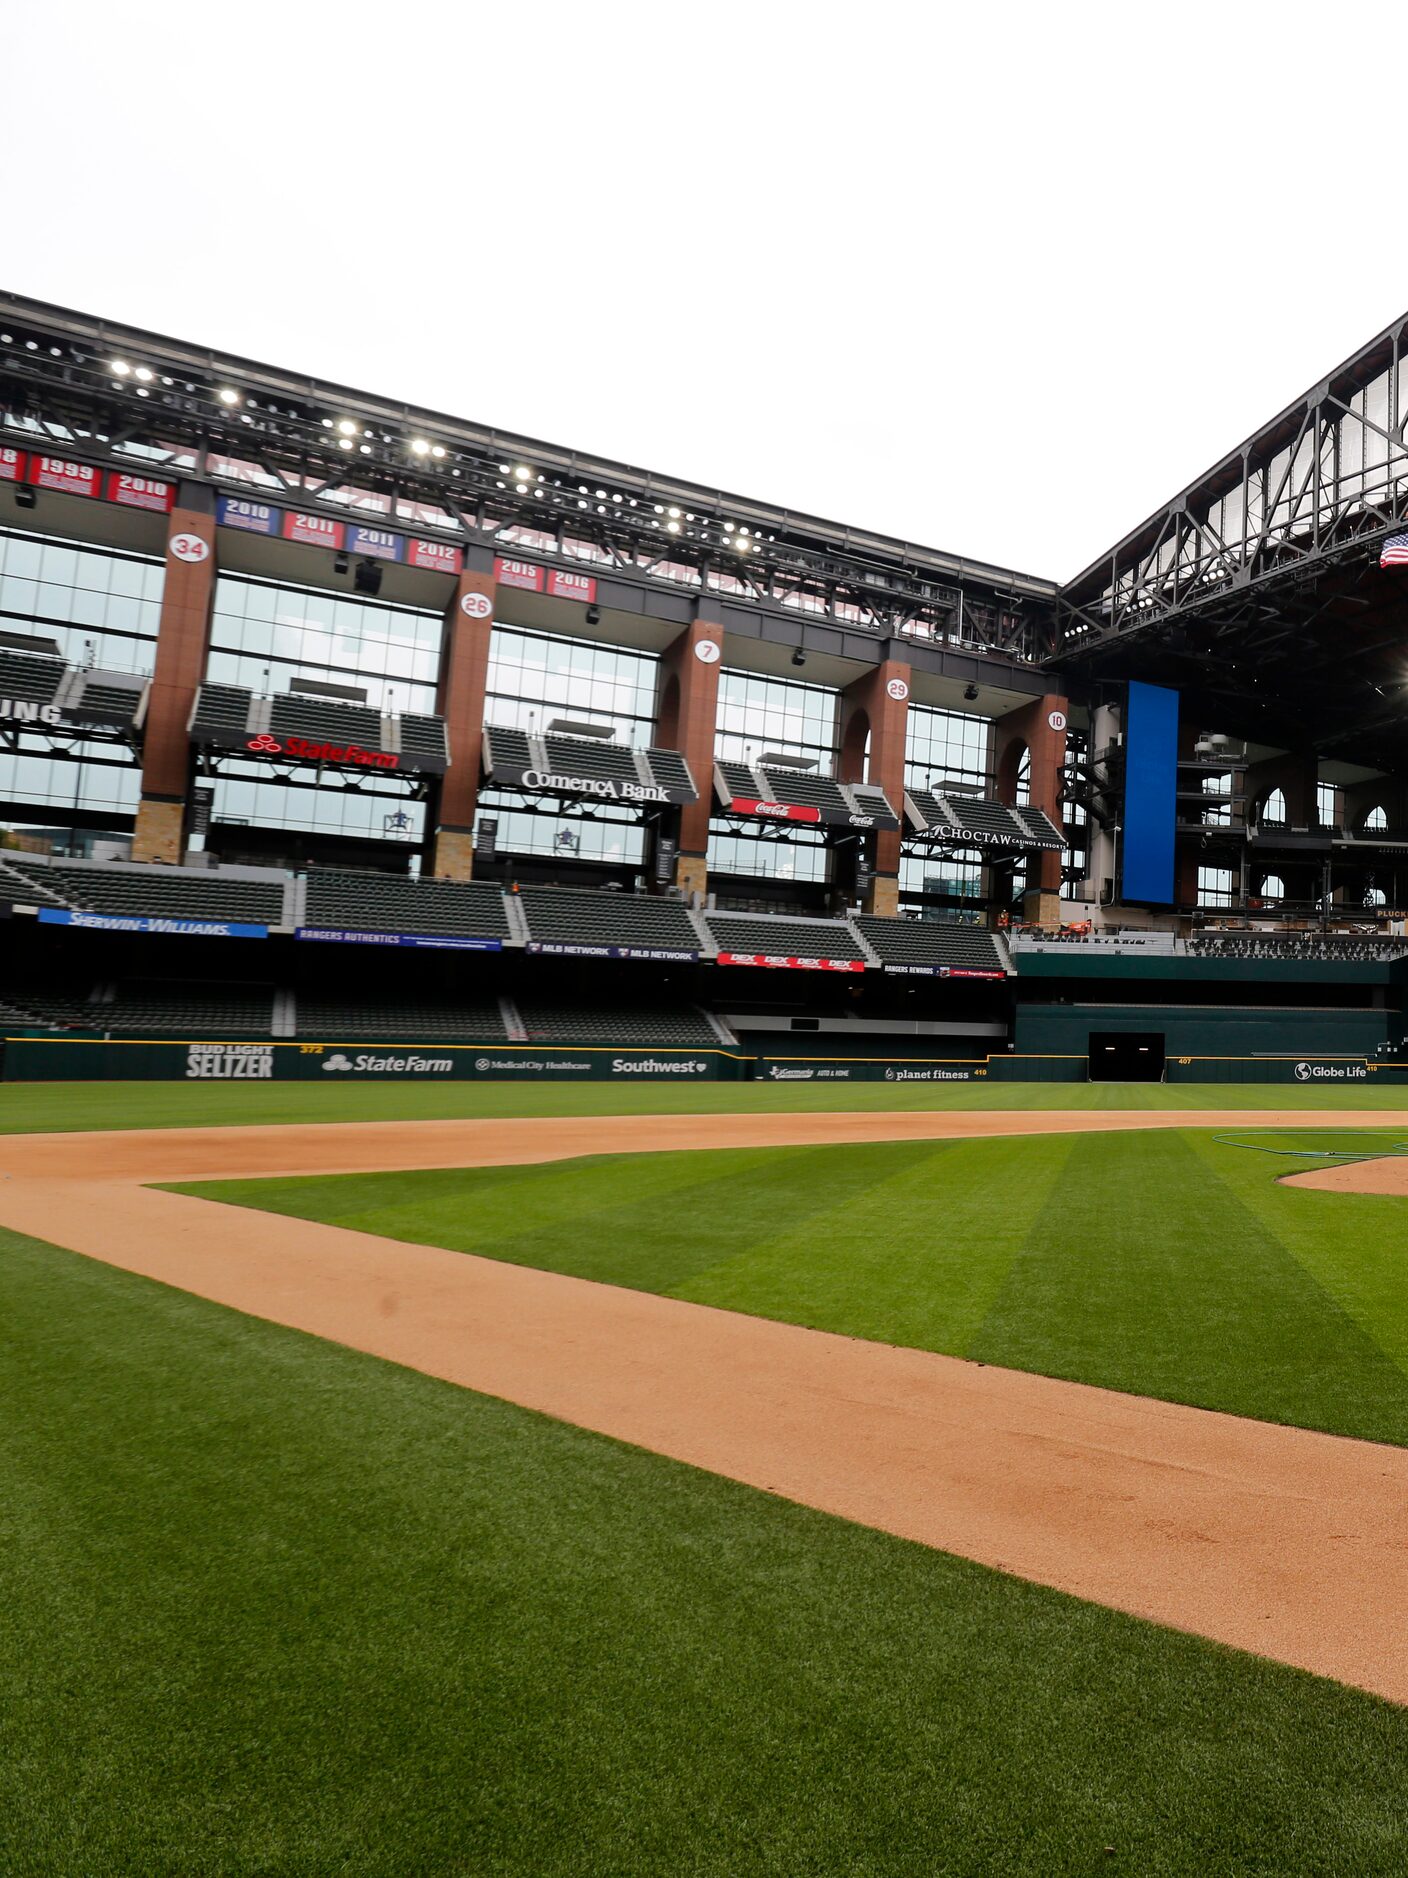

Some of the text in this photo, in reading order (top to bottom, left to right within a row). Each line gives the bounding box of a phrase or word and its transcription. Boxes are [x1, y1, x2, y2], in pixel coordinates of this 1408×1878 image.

[41, 457, 94, 480] 1999
[120, 475, 168, 496] 2010
[227, 499, 270, 520] 2010
[296, 514, 334, 533] 2011
[358, 528, 394, 547] 2011
[176, 539, 203, 558] 34
[417, 541, 456, 560] 2012
[502, 561, 536, 577] 2015
[555, 571, 589, 588] 2016
[466, 597, 487, 613] 26
[704, 645, 713, 657] 7
[890, 683, 906, 696] 29
[1052, 715, 1062, 727] 10
[620, 782, 671, 802] Bank
[755, 802, 791, 816] Coca-Cola
[849, 815, 875, 826] Coca-Cola
[940, 825, 1011, 845] CHOCTAW
[300, 929, 342, 940] RANGERS
[344, 932, 399, 943] AUTHENTICS
[542, 944, 692, 960] MLB NETWORK MLB NETWORK
[884, 965, 933, 974] RANGERS REWARDS
[189, 1045, 274, 1055] BUD LIGHT
[300, 1045, 324, 1054] 372
[186, 1054, 273, 1077] SELTZER
[491, 1061, 592, 1071] Medical City Healthcare
[612, 1059, 695, 1073] Southwest
[1313, 1066, 1366, 1077] Globe Life
[896, 1068, 969, 1080] planet fitness
